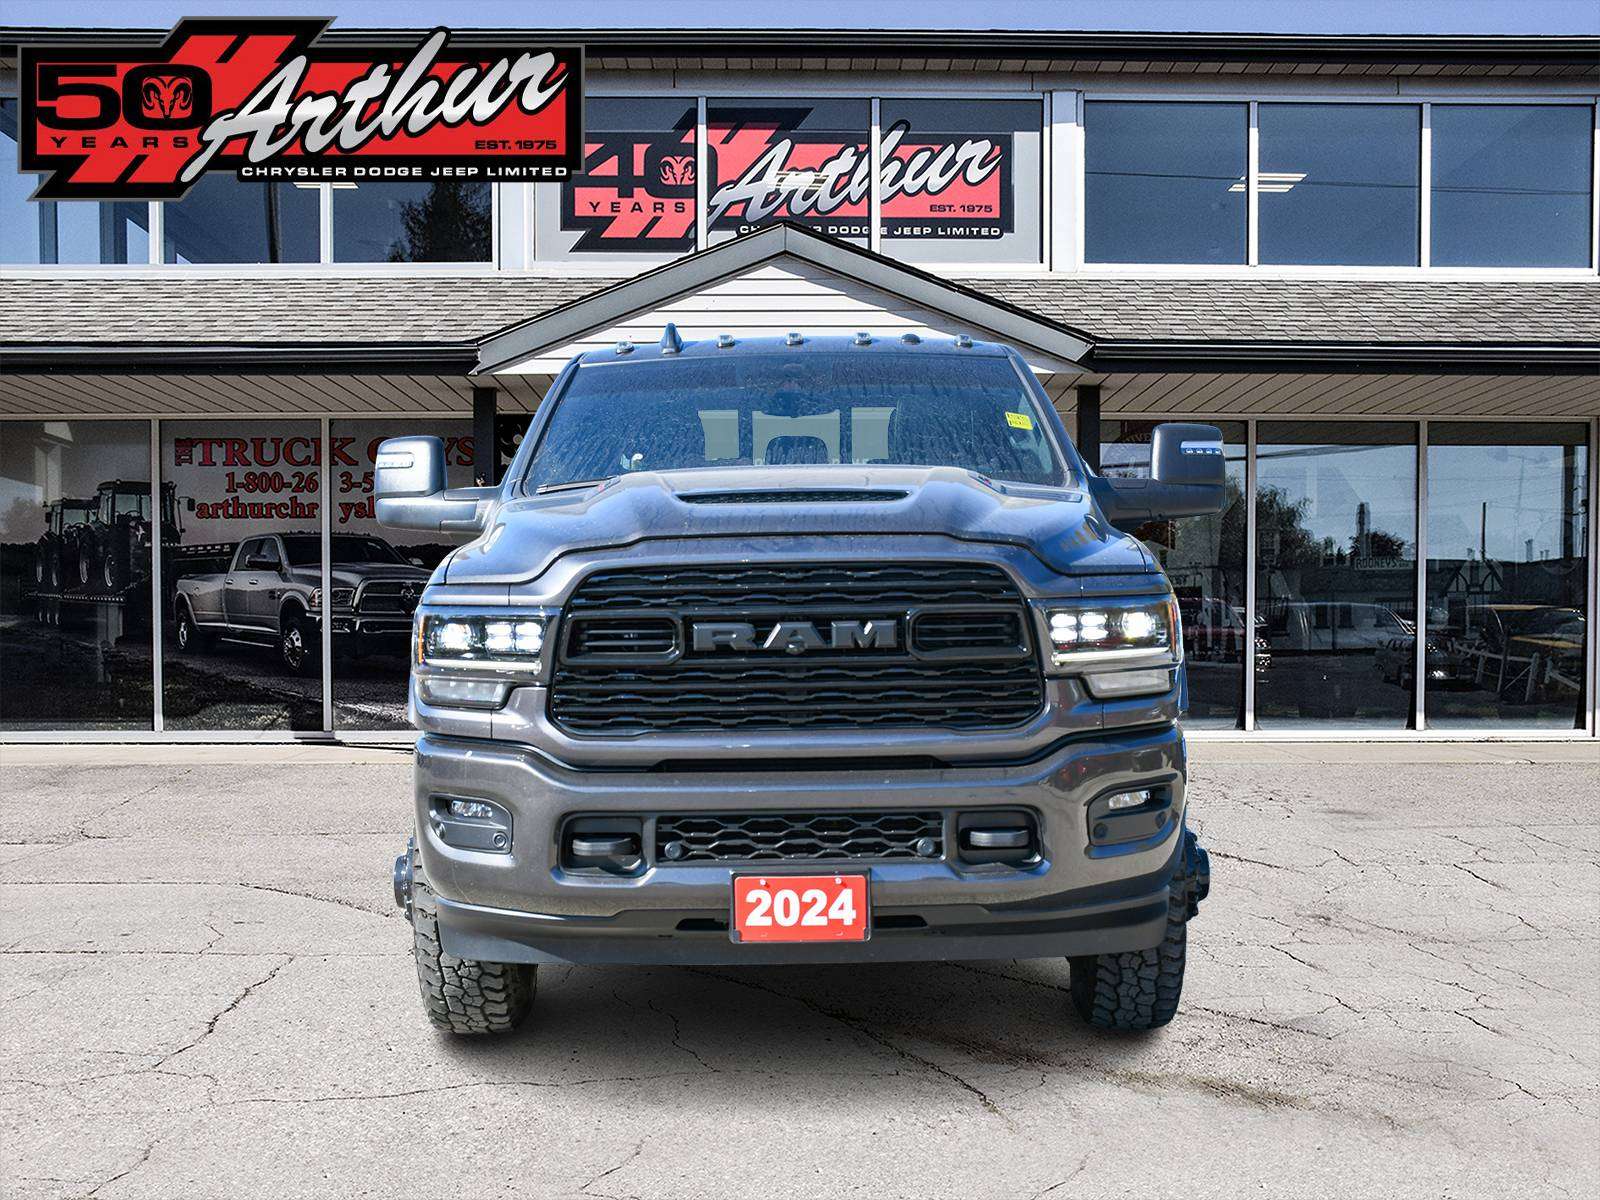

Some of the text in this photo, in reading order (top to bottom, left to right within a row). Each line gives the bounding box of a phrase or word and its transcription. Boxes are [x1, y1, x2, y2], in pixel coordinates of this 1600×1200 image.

[708, 124, 1003, 223] Arthur
[589, 201, 686, 213] YEARS
[929, 204, 993, 213] EST. 1975
[893, 226, 932, 236] JEEP
[938, 227, 1000, 236] LIMITED
[193, 436, 359, 467] TRUCK
[693, 620, 897, 651] RAM
[745, 888, 856, 927] 2024
